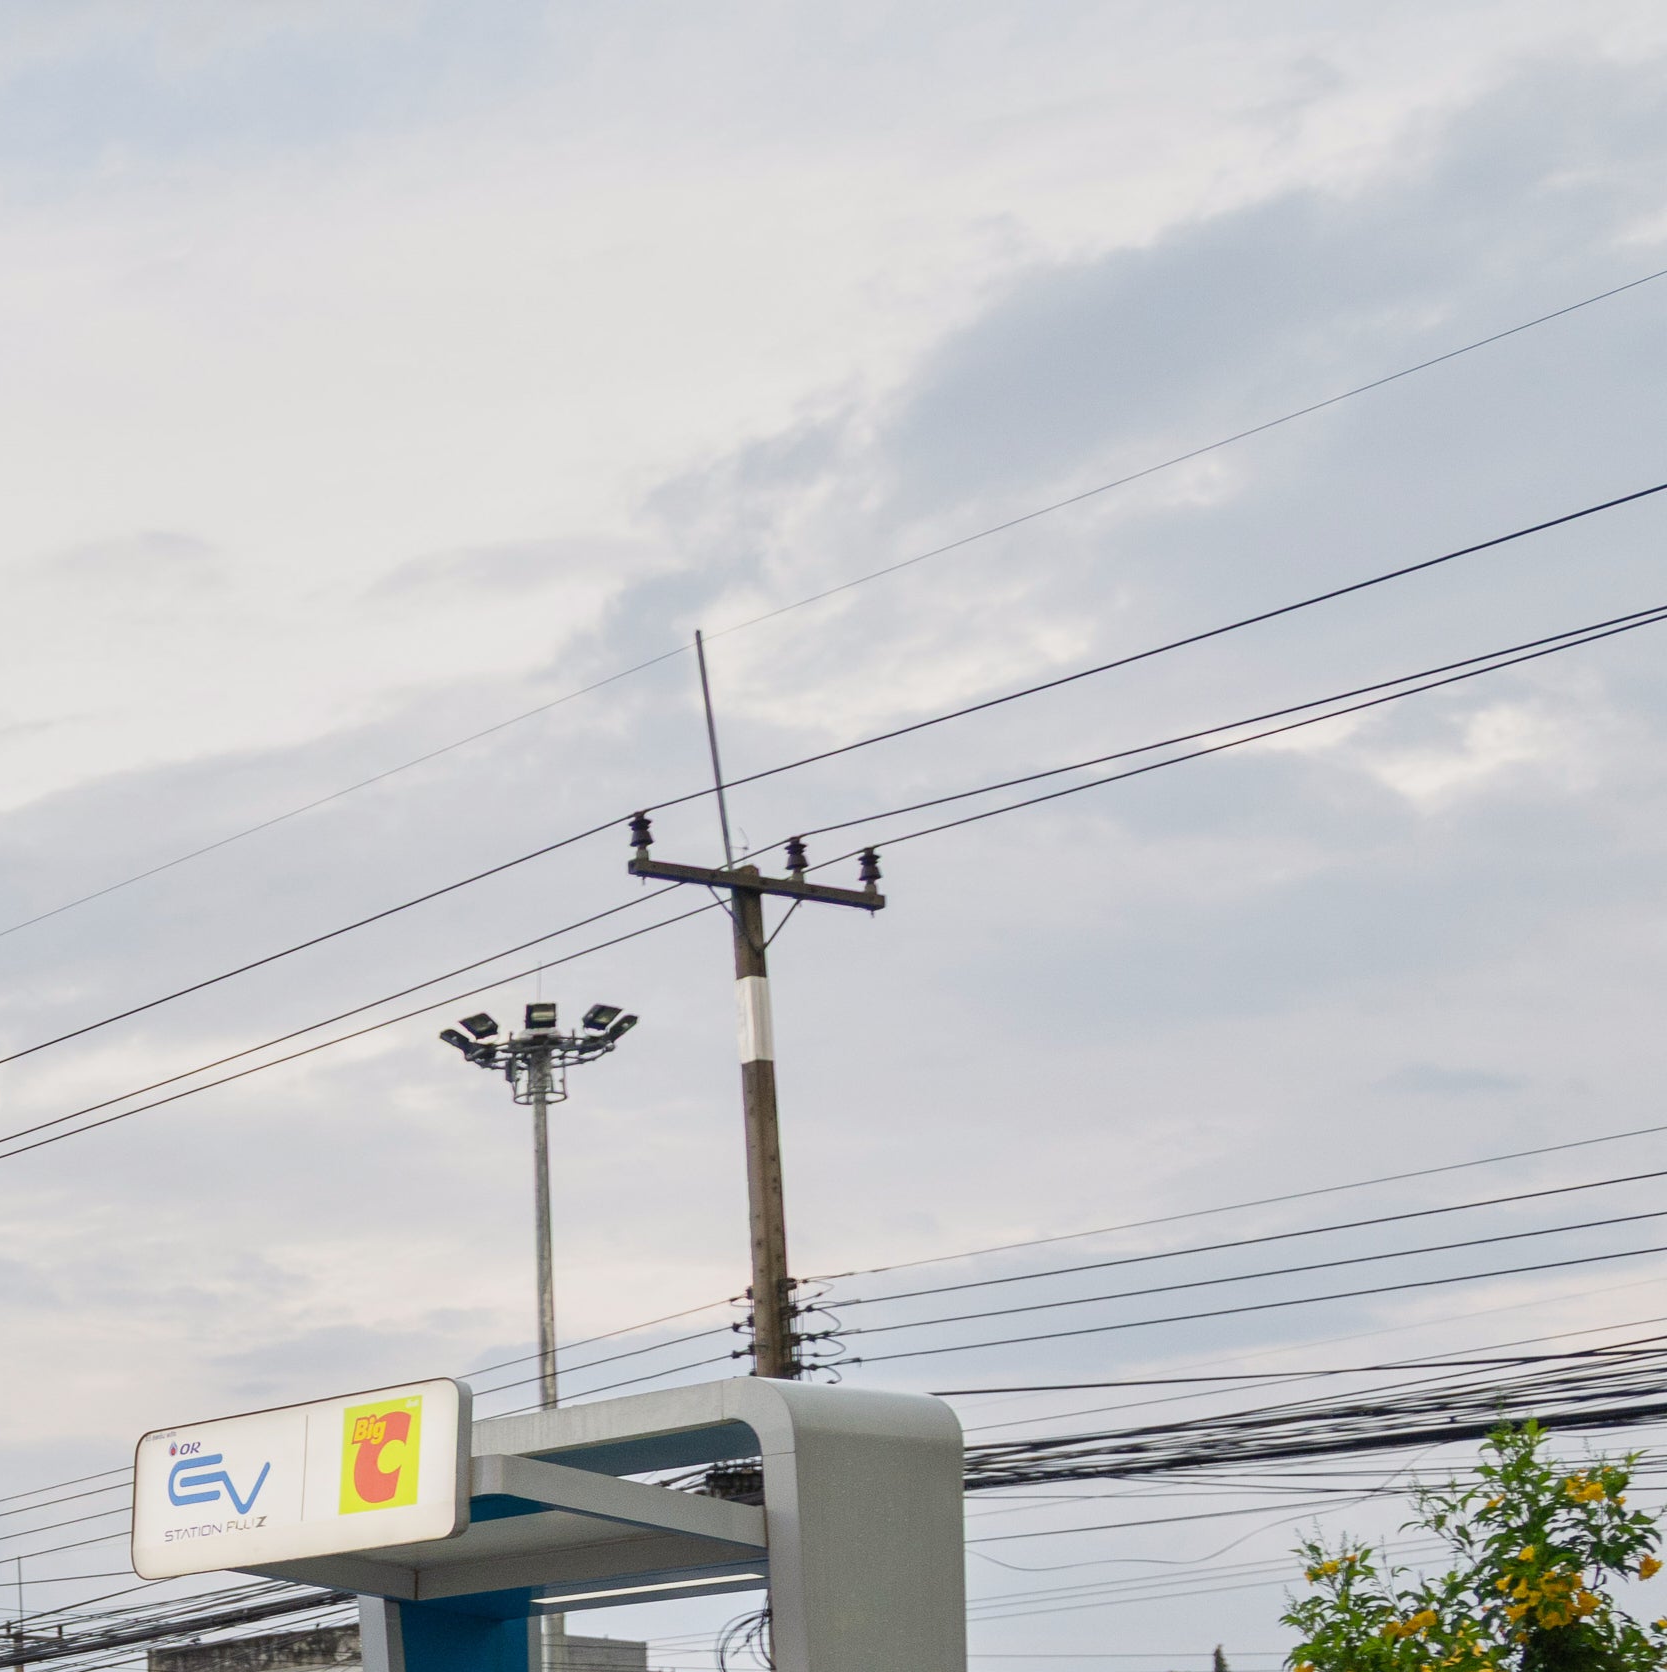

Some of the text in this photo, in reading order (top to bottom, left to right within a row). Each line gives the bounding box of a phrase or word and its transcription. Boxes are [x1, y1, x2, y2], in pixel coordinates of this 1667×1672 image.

[352, 1414, 387, 1445] Big
[179, 1441, 201, 1455] OR
[168, 1453, 271, 1515] EV
[164, 1523, 223, 1542] STATION
